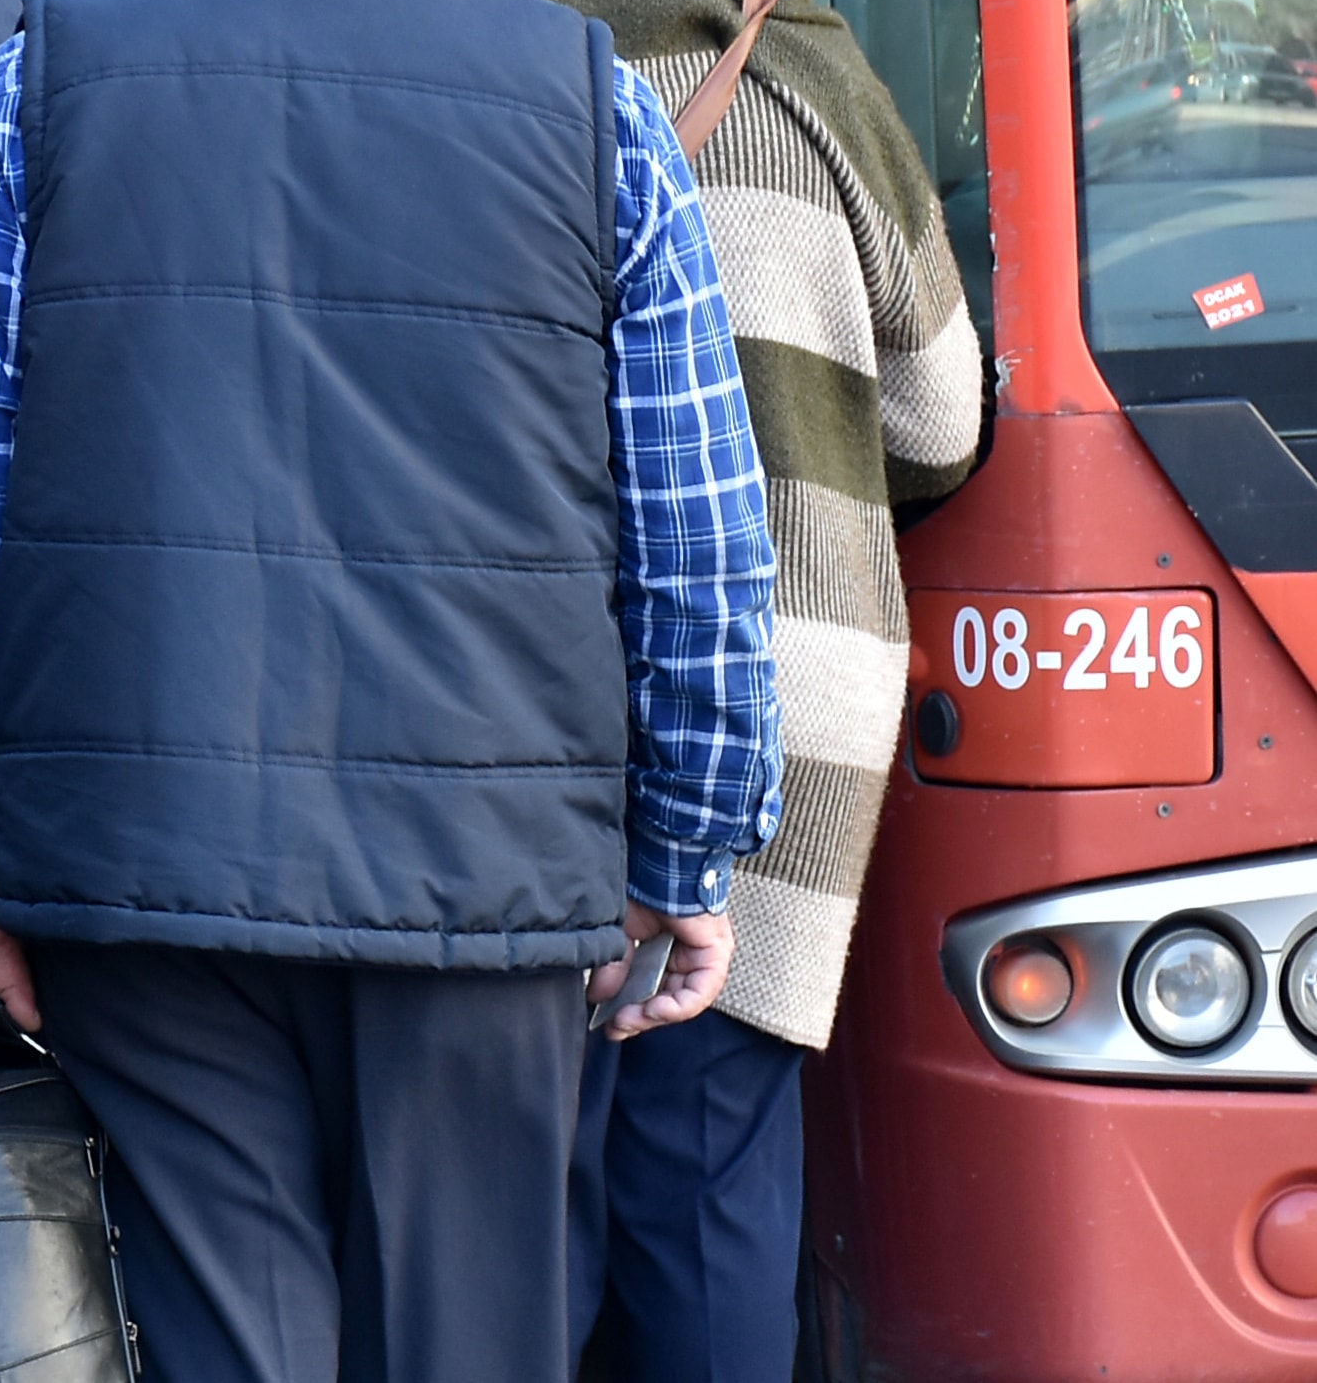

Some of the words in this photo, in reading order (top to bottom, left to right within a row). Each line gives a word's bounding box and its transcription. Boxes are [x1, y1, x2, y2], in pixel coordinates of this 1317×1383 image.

[1203, 281, 1247, 307] OCAK
[1205, 298, 1256, 328] 2021
[952, 605, 1204, 690] 08-246
